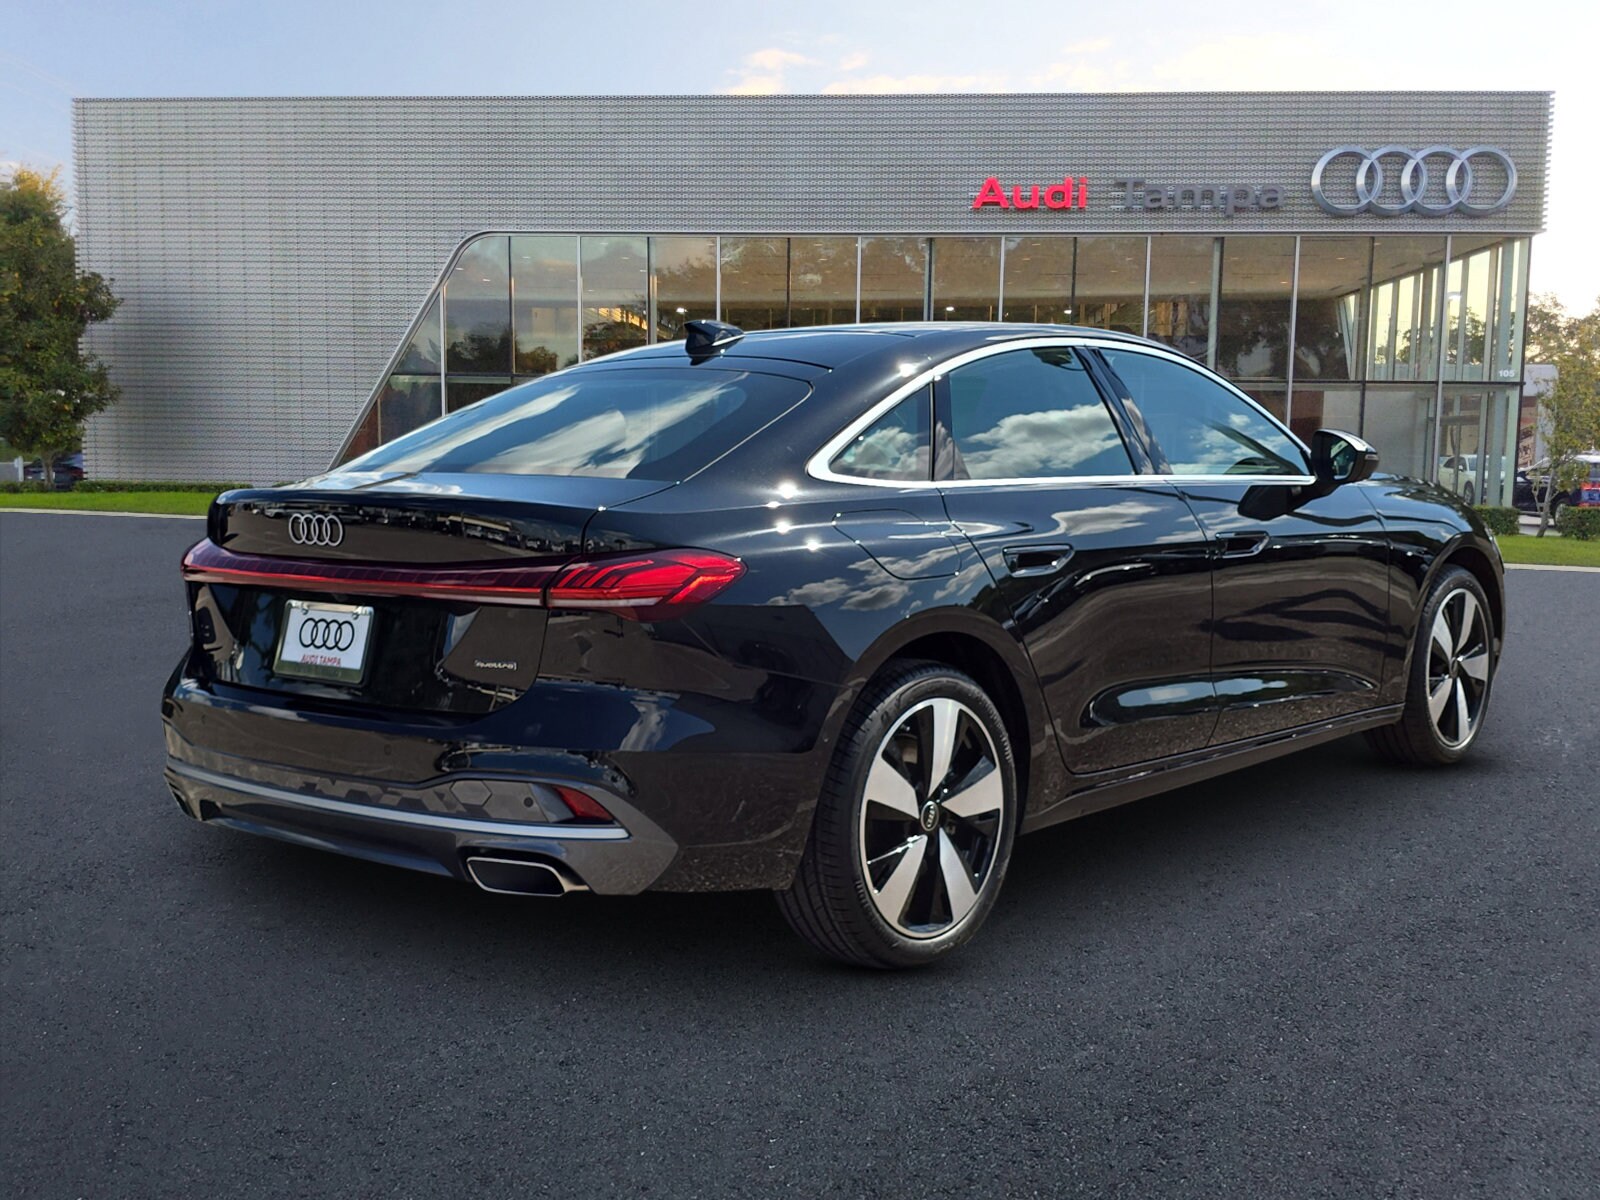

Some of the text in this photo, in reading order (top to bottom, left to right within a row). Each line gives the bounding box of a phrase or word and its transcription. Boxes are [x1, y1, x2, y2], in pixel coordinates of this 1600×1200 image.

[971, 177, 1285, 217] Audi Tampa
[300, 654, 341, 667] AUDI TAMPA
